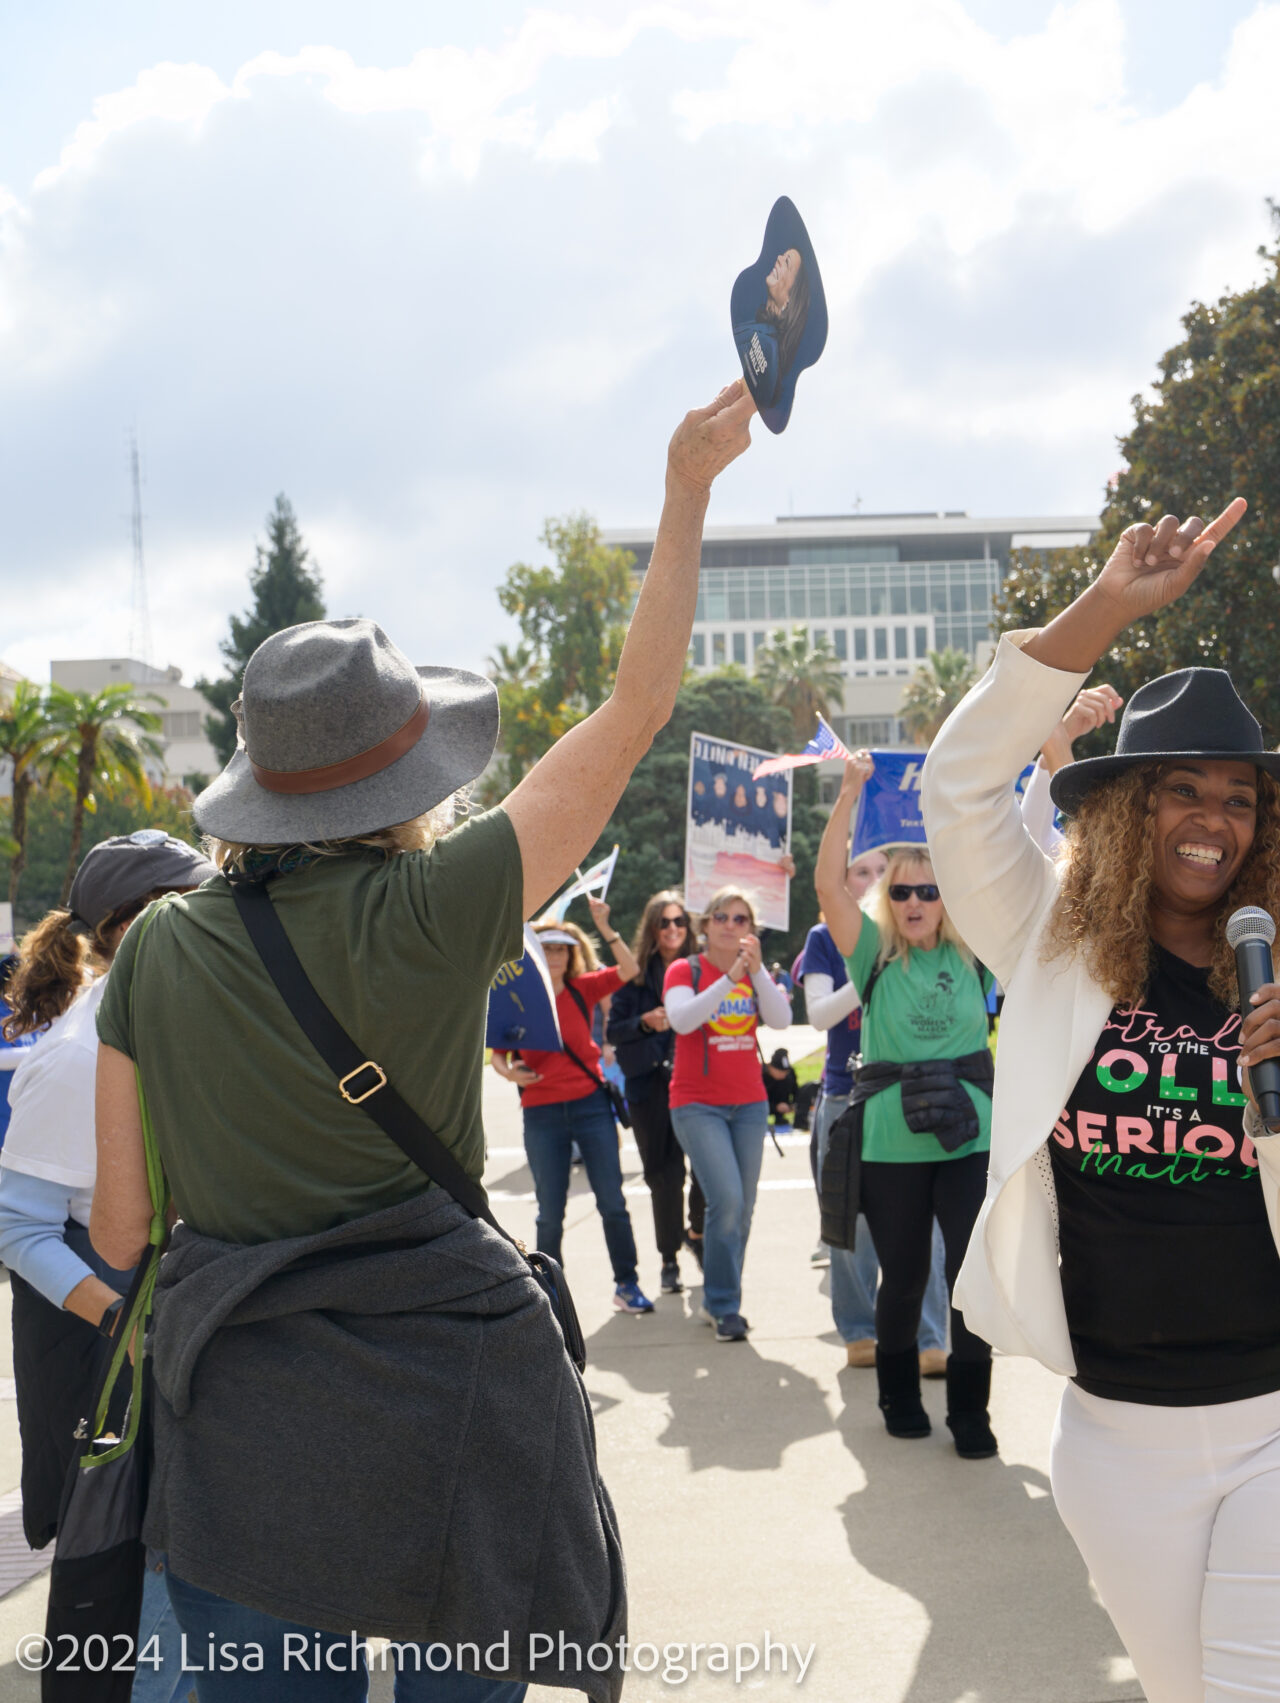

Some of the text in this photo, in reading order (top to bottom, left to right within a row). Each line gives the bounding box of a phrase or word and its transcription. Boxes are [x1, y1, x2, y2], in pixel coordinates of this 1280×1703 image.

[749, 347, 760, 376] WALZ
[751, 331, 768, 374] HARRIS
[710, 998, 756, 1021] AMAL
[1148, 1041, 1210, 1055] TO THE
[1087, 1048, 1249, 1107] OLL
[1146, 1104, 1202, 1122] IT'S A
[1052, 1109, 1258, 1169] SERIO
